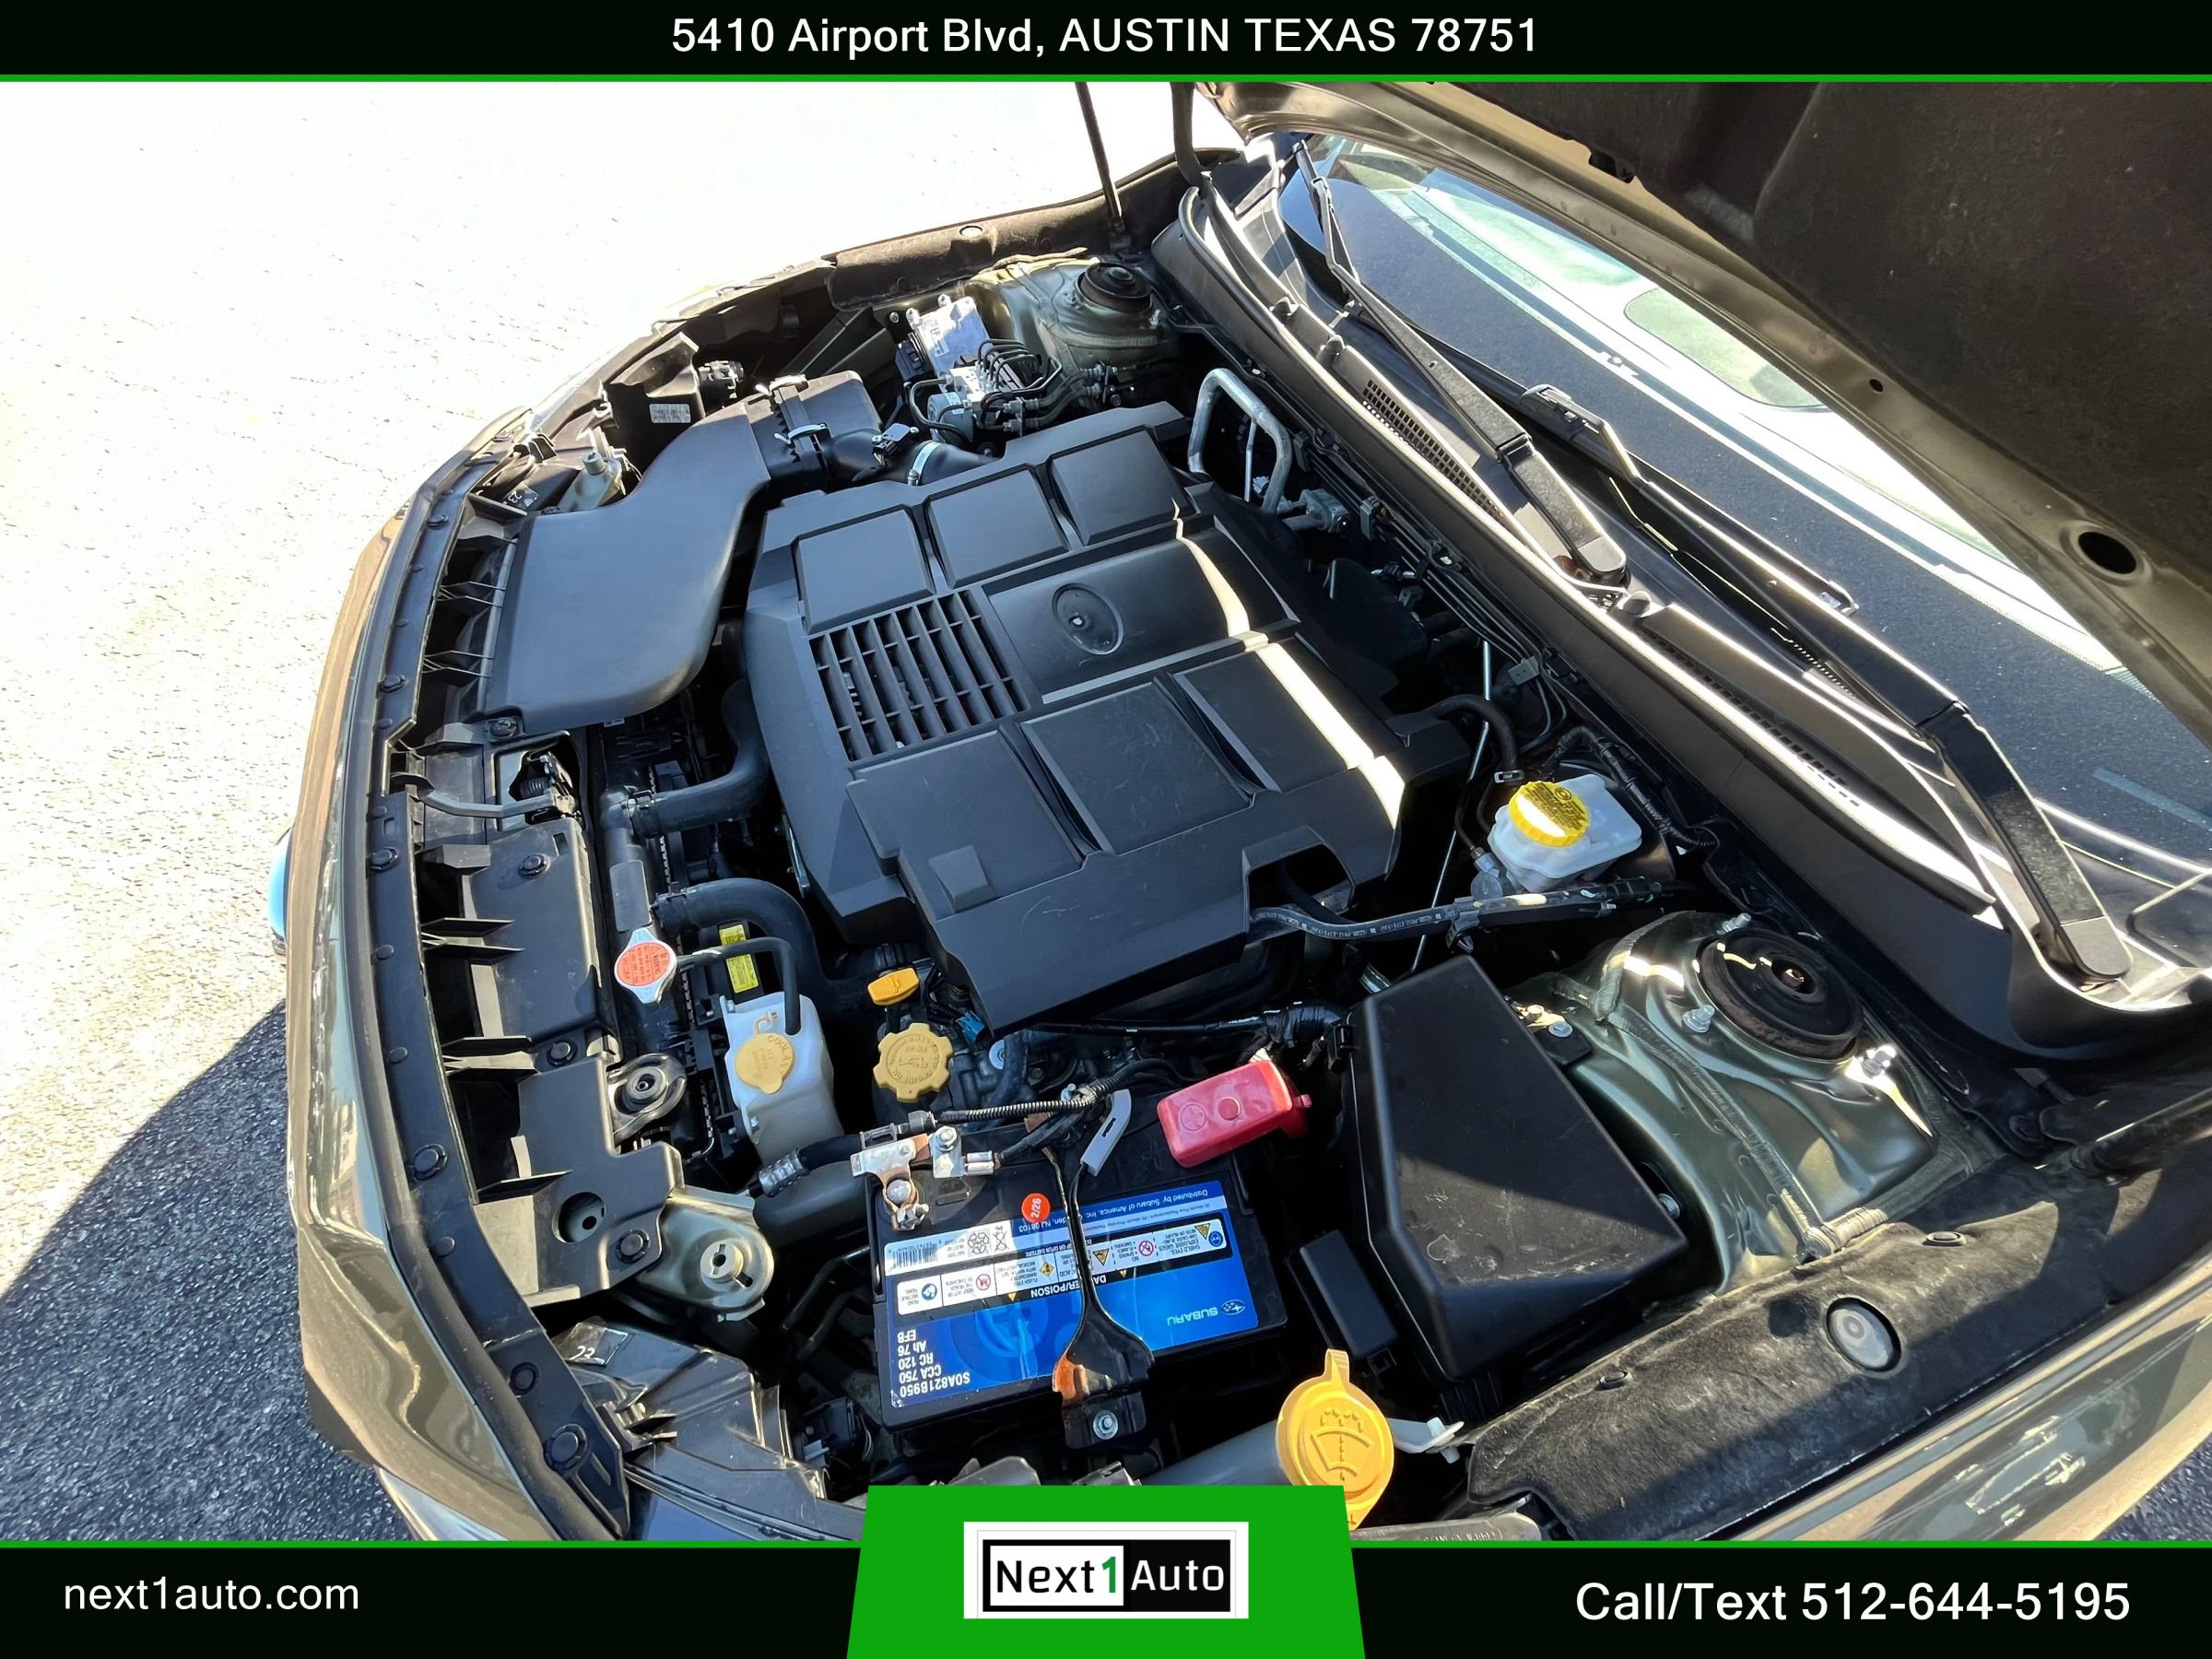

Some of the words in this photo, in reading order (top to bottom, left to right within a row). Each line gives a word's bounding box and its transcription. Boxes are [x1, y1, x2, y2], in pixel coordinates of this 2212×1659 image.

[1172, 1189, 1207, 1202] Distributed
[1030, 1197, 1041, 1218] 2/26
[1136, 1198, 1159, 1208] Subaru
[1018, 1222, 1039, 1232] 08103
[1174, 1238, 1198, 1247] EXPLOSIVE
[1030, 1274, 1106, 1298] DAER/POISON
[1168, 1308, 1218, 1323] SUBARU
[898, 1329, 916, 1343] EFB
[898, 1344, 911, 1357] 76
[912, 1340, 926, 1353] Ah
[899, 1357, 916, 1370] 120
[919, 1353, 933, 1366] RC
[900, 1370, 918, 1383] 750
[920, 1364, 941, 1379] CCA
